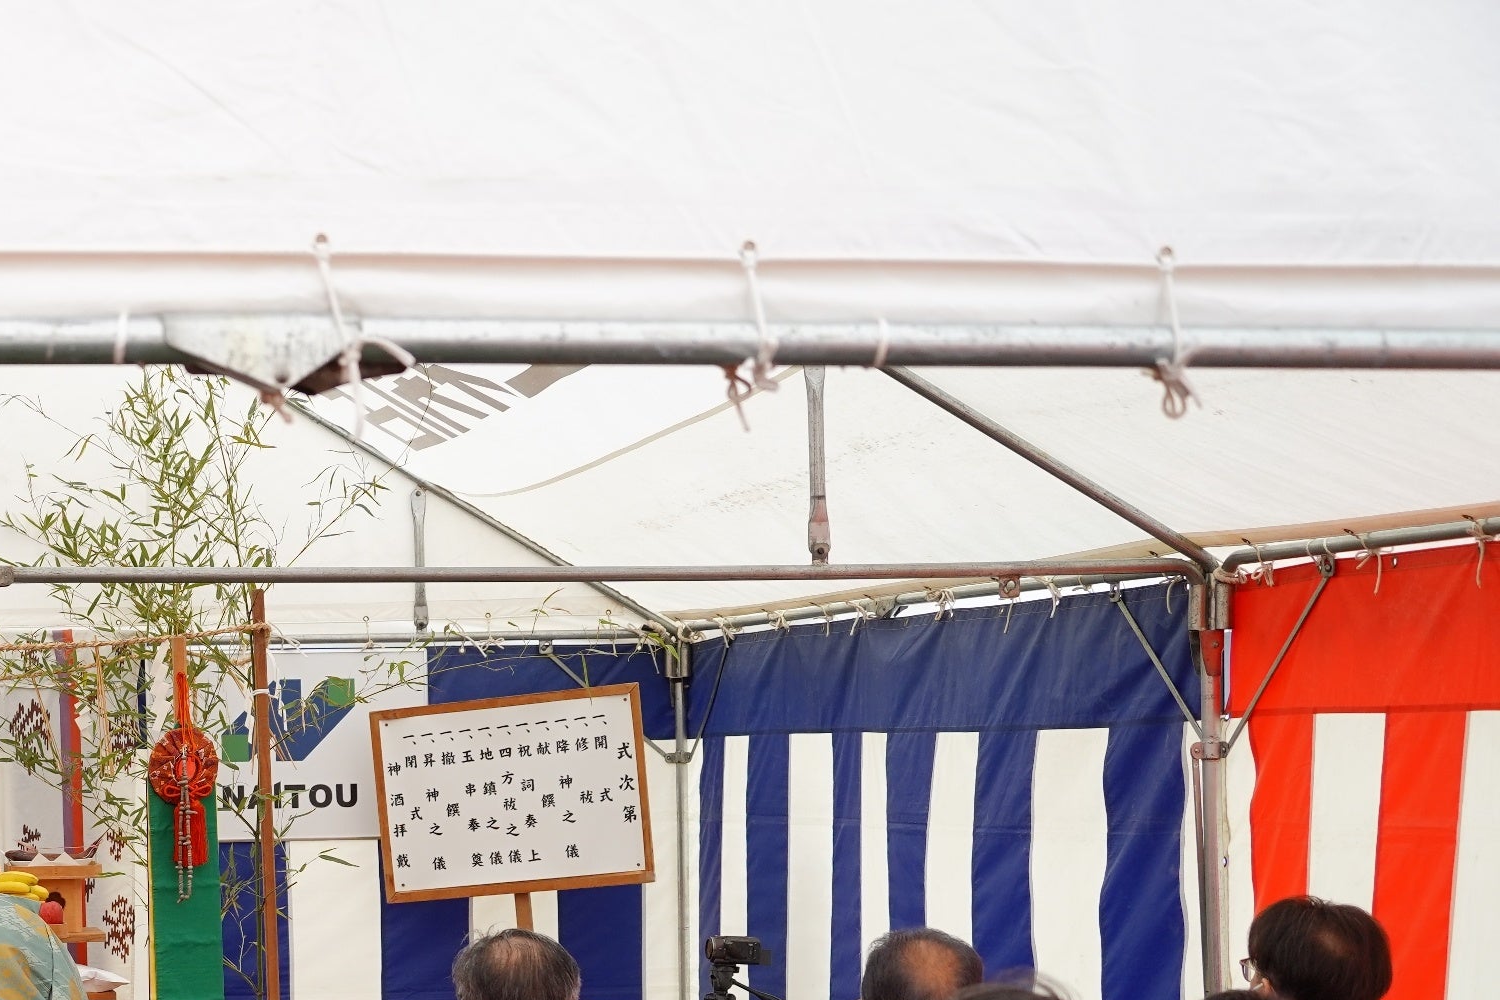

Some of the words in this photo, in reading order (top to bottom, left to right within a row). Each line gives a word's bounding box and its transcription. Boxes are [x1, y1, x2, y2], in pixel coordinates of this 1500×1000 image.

[387, 762, 411, 869] 神酒拝戴
[617, 742, 637, 824] 式次第
